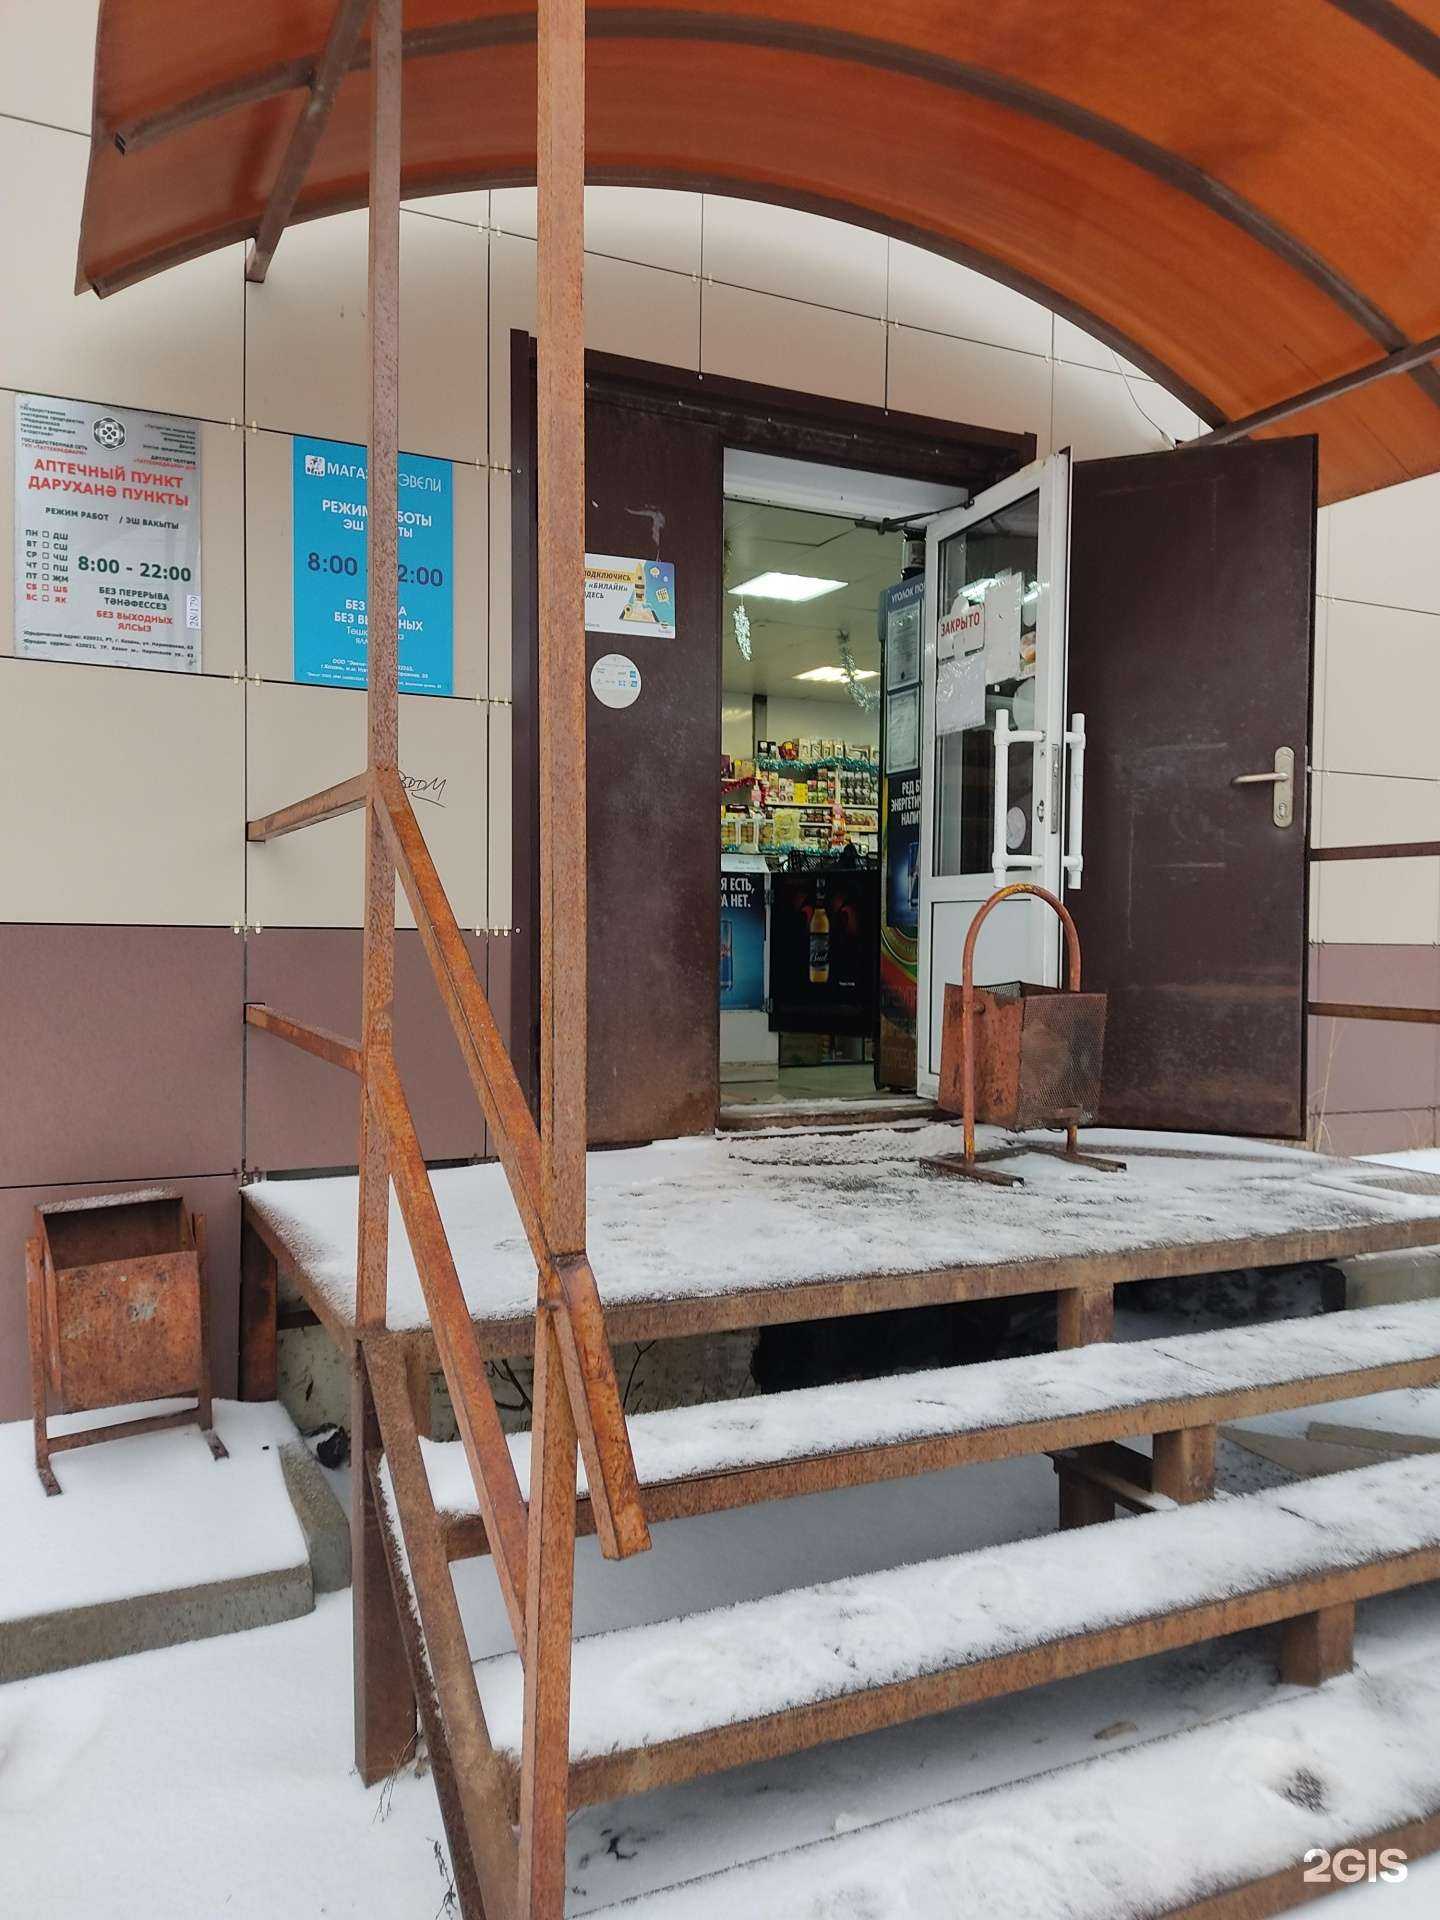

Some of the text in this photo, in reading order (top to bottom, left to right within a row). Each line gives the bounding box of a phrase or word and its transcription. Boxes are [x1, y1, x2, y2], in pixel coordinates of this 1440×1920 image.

[34, 458, 125, 481] АПТЕЧНЫЙ
[131, 471, 184, 488] ПУНКТ
[327, 462, 368, 480] МАГА
[28, 476, 189, 506] ДАРУХАНӘ ПУНКТЫ
[45, 507, 79, 517] РЕЖИМ
[126, 516, 140, 525] ЭШ
[142, 519, 179, 530] ВАКЫТЫ
[343, 519, 364, 531] ЭШ
[397, 511, 432, 527] БОТЫ
[25, 529, 69, 540] ПН ДШ
[53, 553, 68, 561] ЧШ
[53, 564, 68, 572] ПШ
[78, 556, 120, 574] 8:00
[140, 562, 191, 582] 22:00
[307, 552, 443, 587] 8:00 2:00
[53, 585, 68, 593] ШБ
[99, 586, 170, 601] БЕЗ ПЕРЕРЫВА
[585, 591, 605, 599] ДЕСЬ
[345, 599, 366, 611] БЕЗ
[96, 610, 173, 625] БЕЗ ВЫХОДНЫХ
[334, 611, 355, 624] БЕЗ
[940, 611, 980, 637] ЗАКРЫТО
[118, 623, 152, 633] ЯЛСЫЗ
[902, 780, 915, 797] РЕД
[891, 794, 921, 812] ЭНЕРГЕТИ
[901, 810, 921, 827] НАПИ
[730, 877, 755, 894] ЕСТЬ,
[730, 893, 751, 908] НЕТ.
